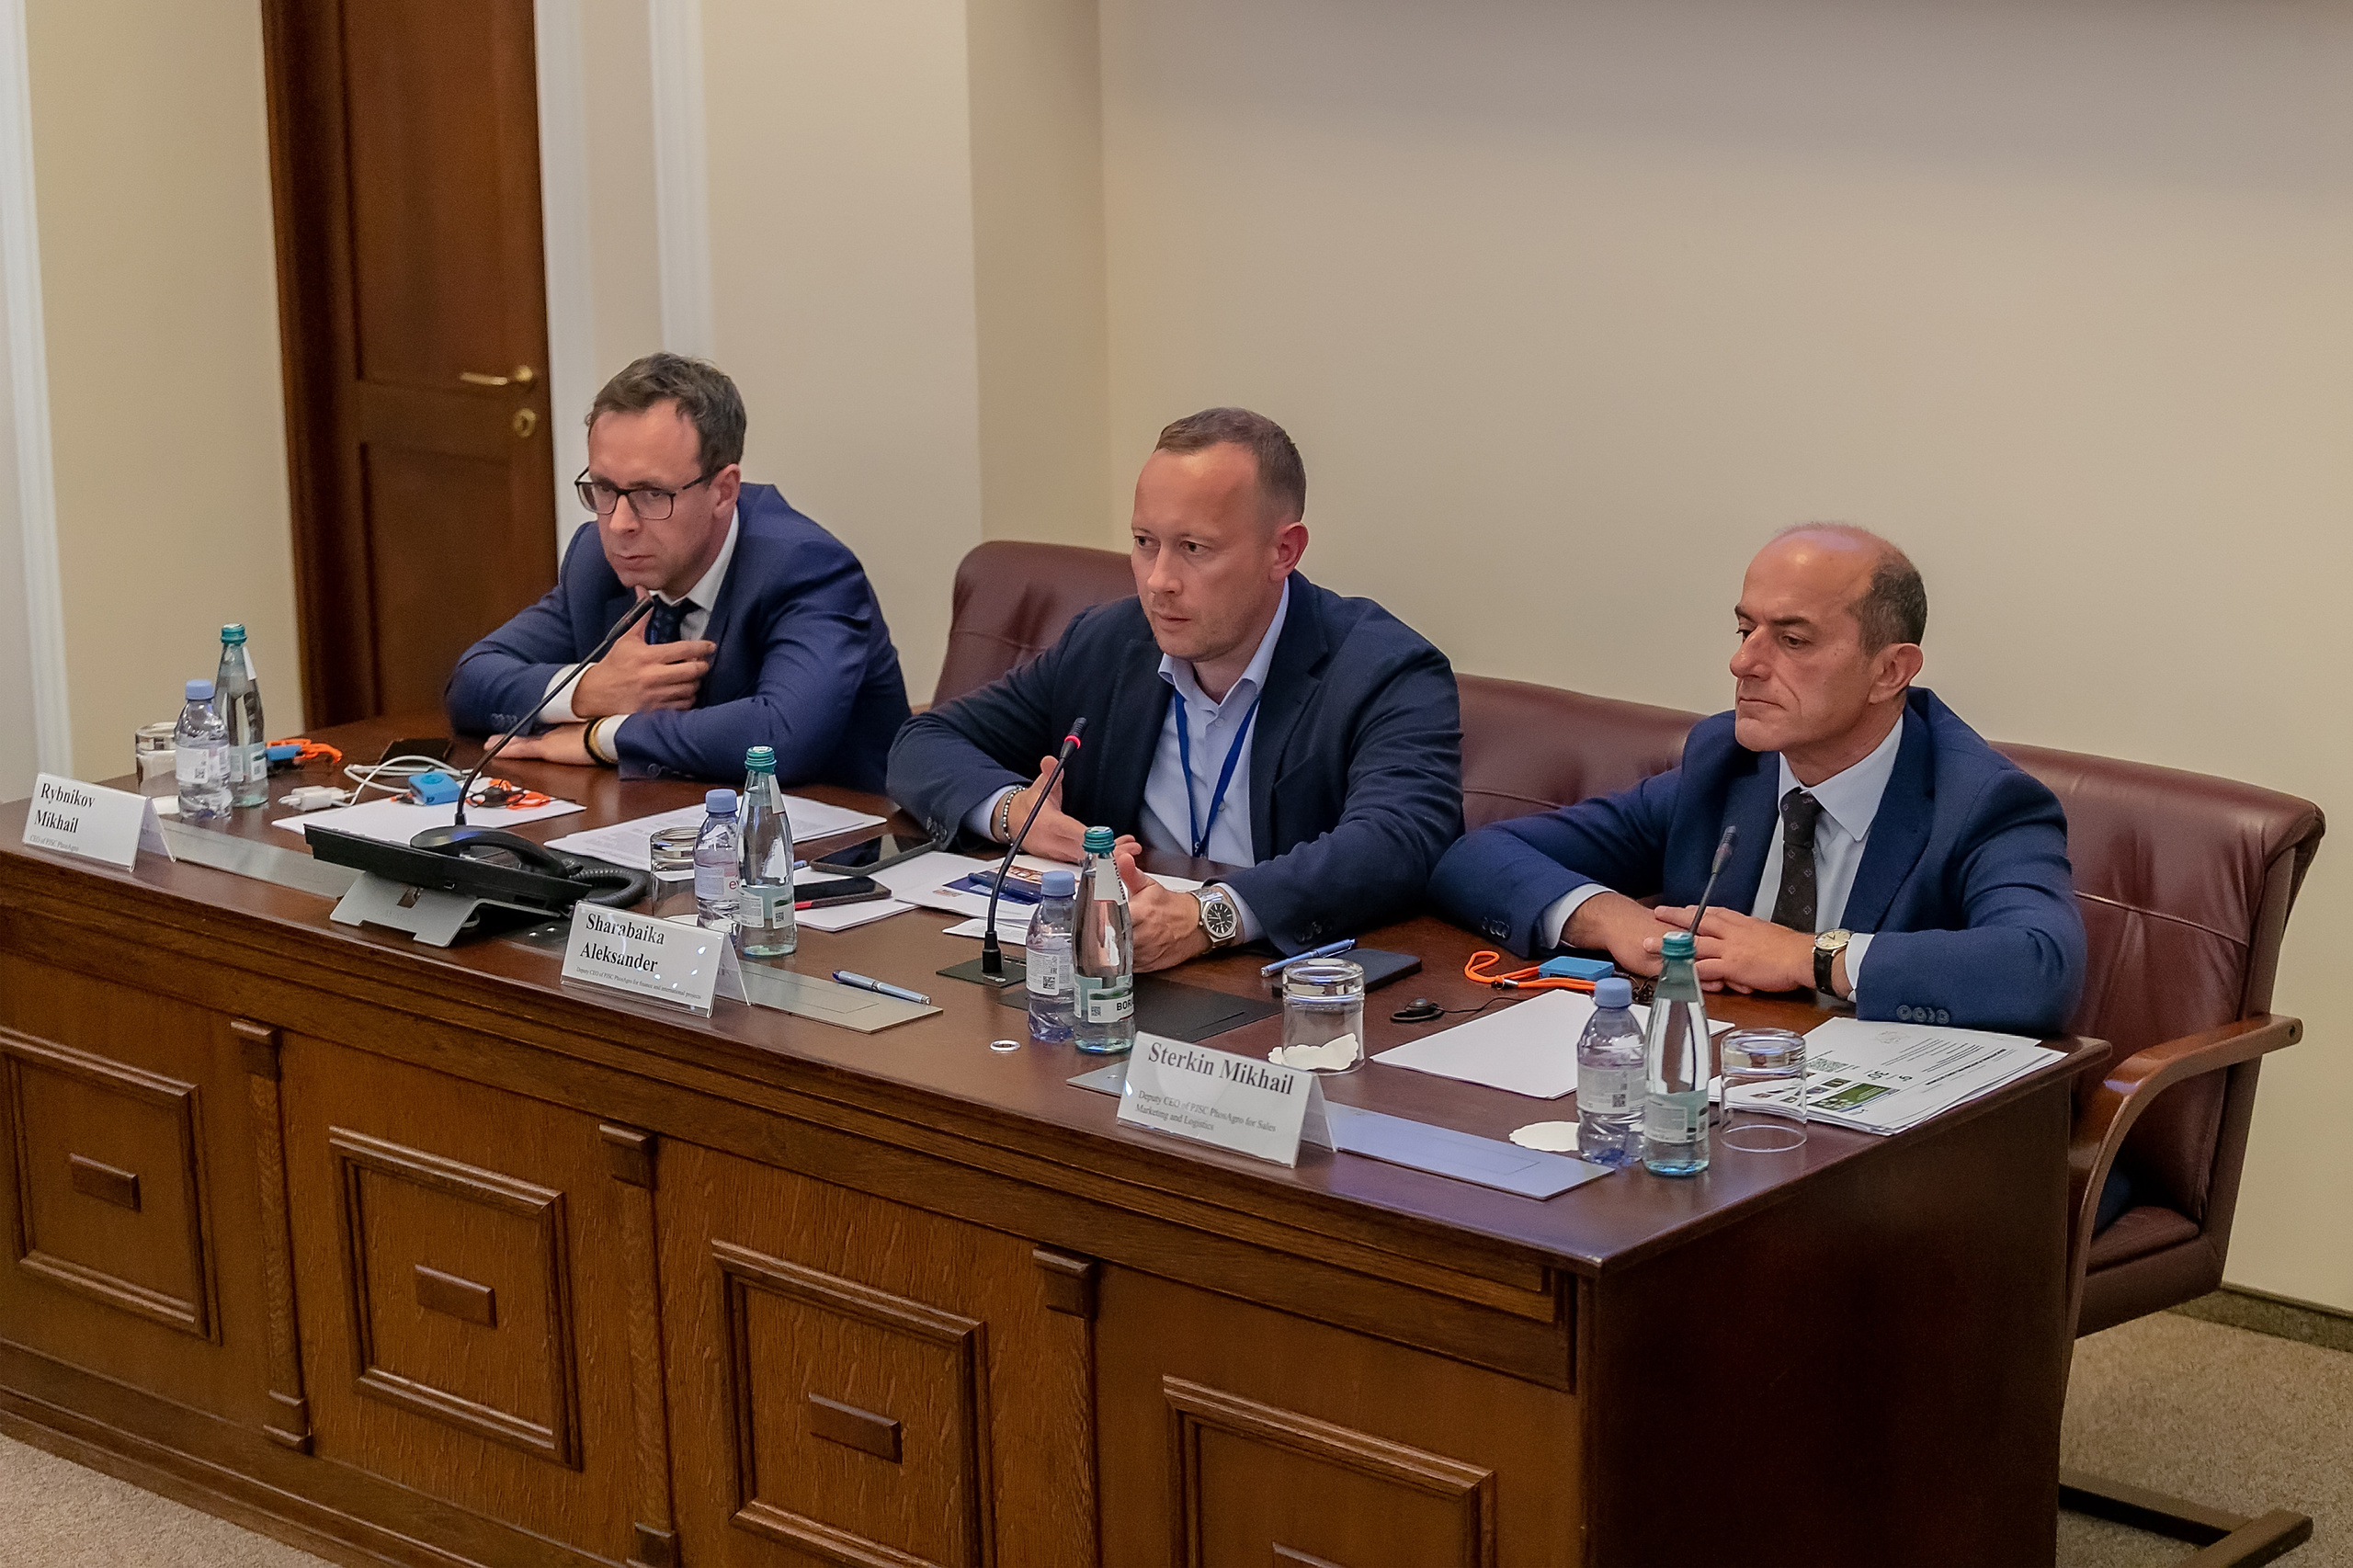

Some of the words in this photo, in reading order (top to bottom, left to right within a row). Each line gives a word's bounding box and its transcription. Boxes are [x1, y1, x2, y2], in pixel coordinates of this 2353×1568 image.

[40, 782, 96, 808] Rybnikov
[34, 810, 79, 833] Mikhail
[585, 913, 665, 945] Sharabaika
[576, 966, 589, 975] Deputy
[580, 942, 658, 972] Aleksander
[1148, 1041, 1215, 1076] Sterkin
[1219, 1058, 1294, 1096] Mikhail
[1135, 1103, 1169, 1121] Marketing
[1169, 1114, 1184, 1123] and
[1184, 1115, 1214, 1131] Logistics
[1139, 1090, 1162, 1106] Deputy
[1163, 1096, 1181, 1108] CEO
[1210, 1107, 1245, 1124] PhosAgro
[1245, 1117, 1257, 1127] for
[1256, 1119, 1277, 1132] Sales
